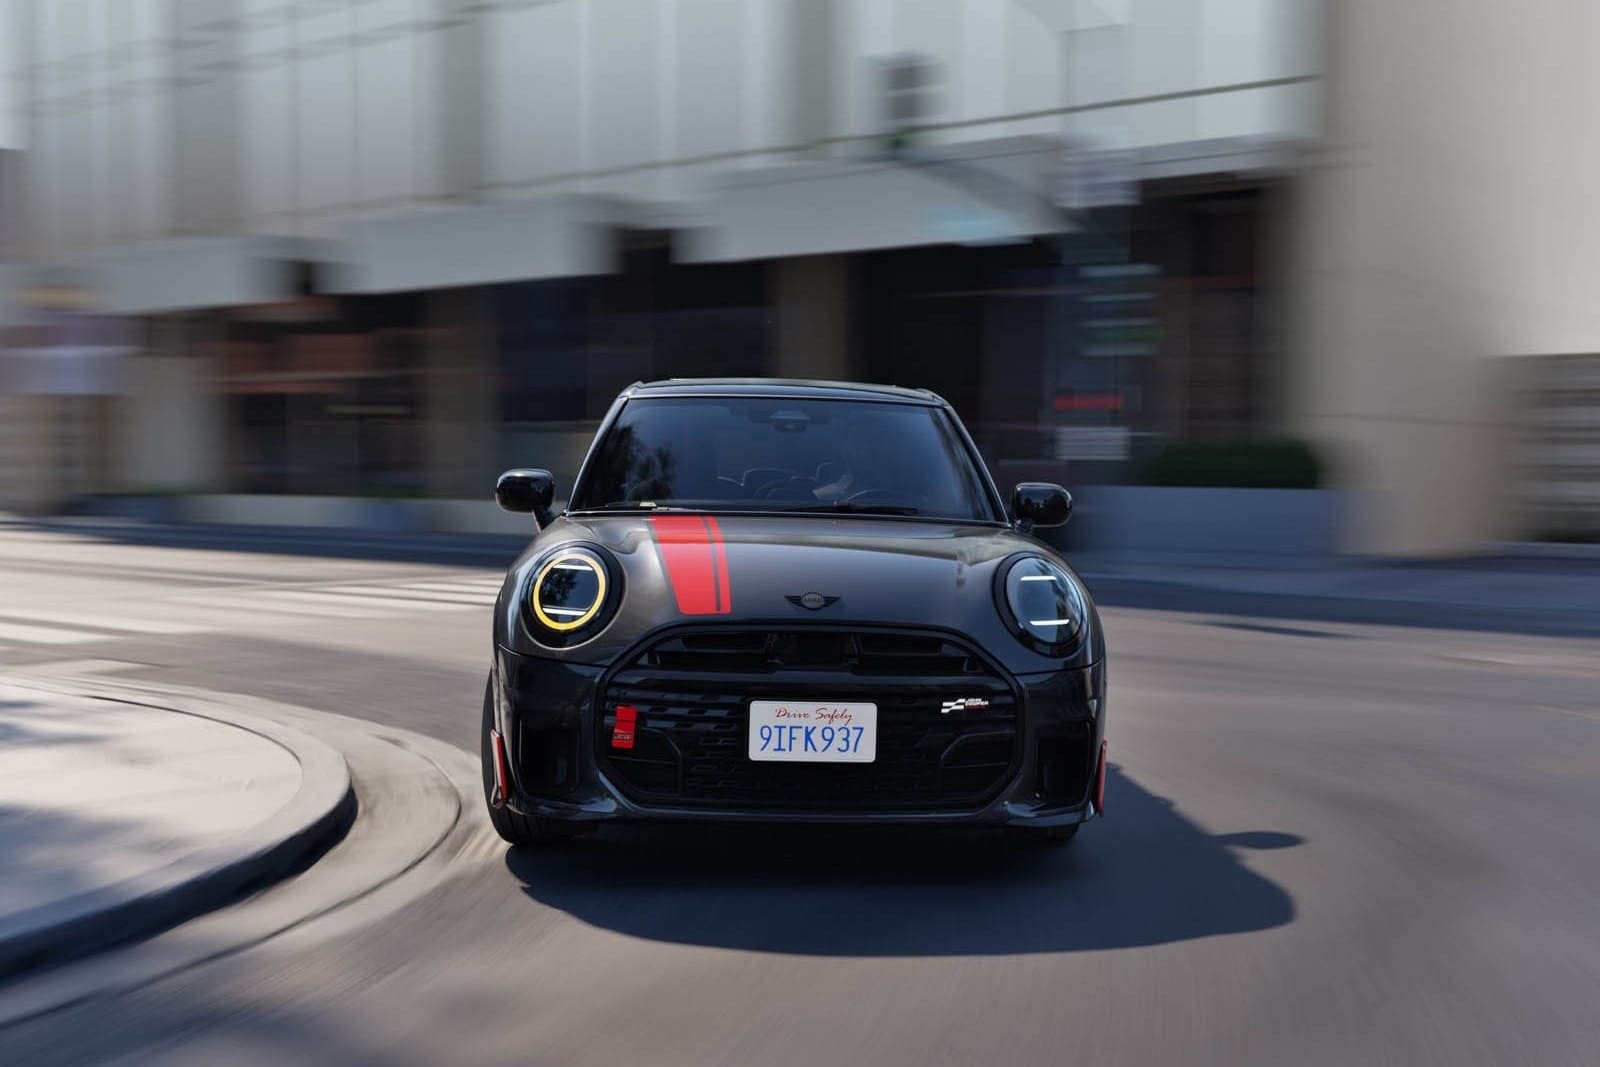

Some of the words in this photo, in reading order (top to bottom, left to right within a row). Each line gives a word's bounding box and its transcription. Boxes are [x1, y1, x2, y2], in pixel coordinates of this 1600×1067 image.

[775, 706, 810, 719] Drive
[815, 707, 853, 725] Safely
[760, 725, 865, 752] 9IFK937
